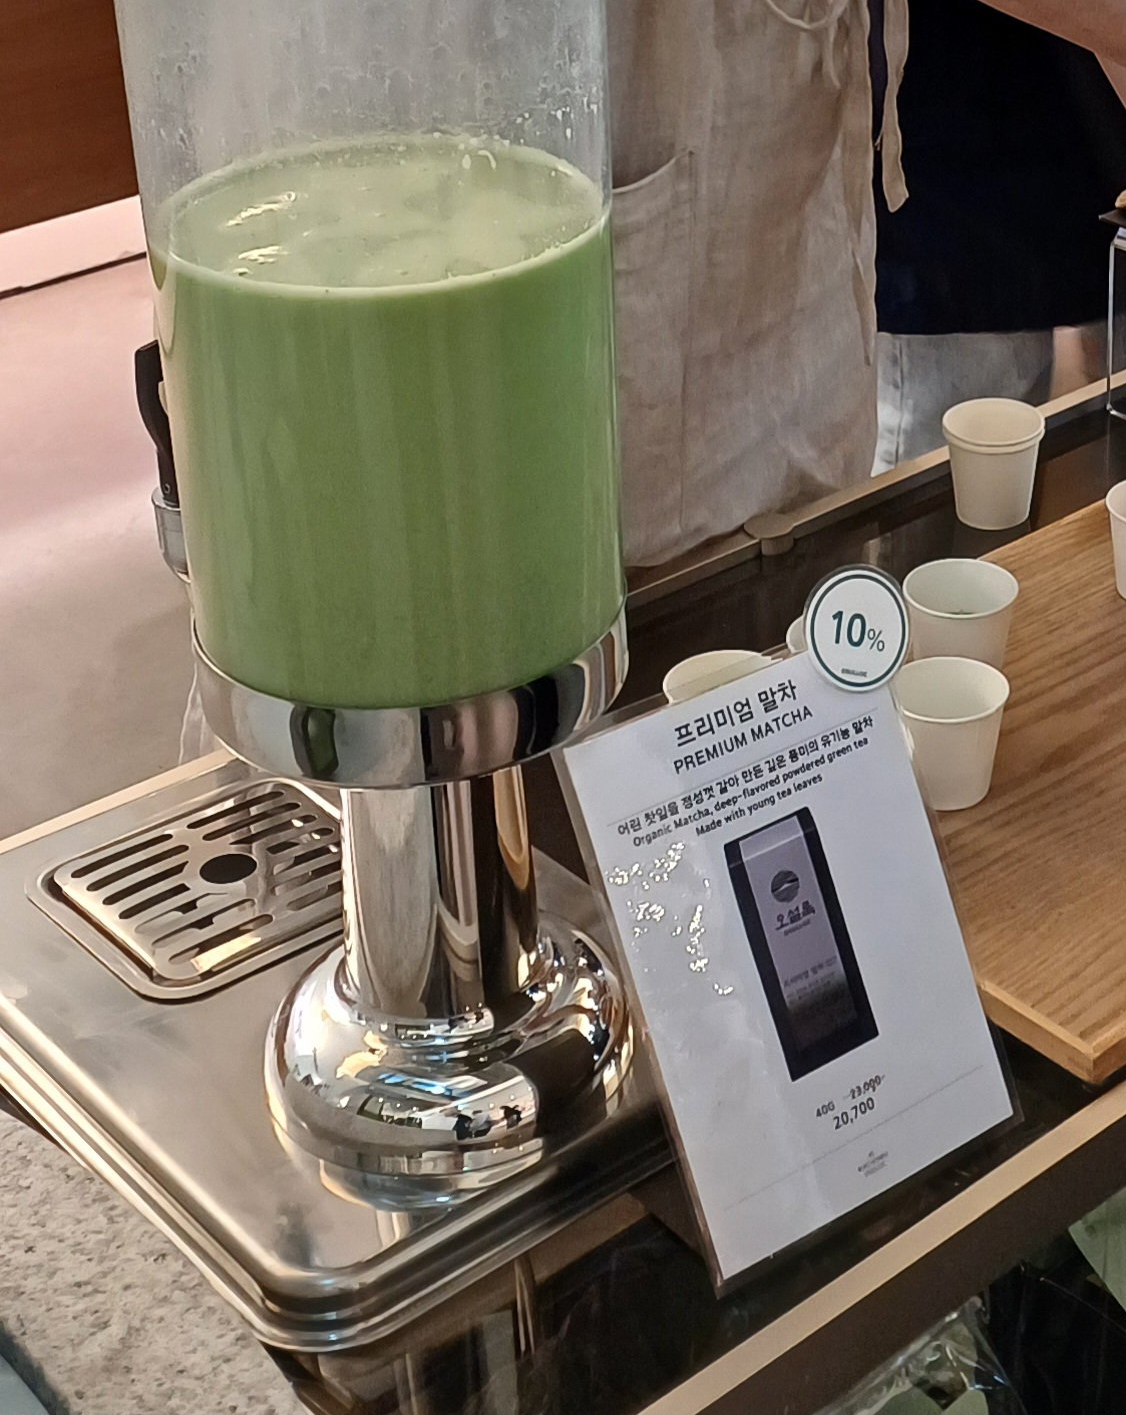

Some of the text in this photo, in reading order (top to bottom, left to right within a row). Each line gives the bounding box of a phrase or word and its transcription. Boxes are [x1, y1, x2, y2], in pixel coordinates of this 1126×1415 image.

[832, 610, 885, 652] 10%
[673, 705, 813, 775] PREMIUM MATCHA
[674, 679, 797, 747] 프리미엄 말차
[617, 817, 643, 836] 어린
[681, 785, 715, 810] 정성껏
[716, 774, 740, 796] 갈아
[741, 764, 764, 784] 만든
[764, 754, 787, 774] 깊은
[788, 739, 819, 764] 풍미의
[851, 715, 874, 735] 말차
[633, 737, 869, 847] Organic Matcha, deep-flavored powdered green tea
[696, 773, 823, 837] Made with young tea leaves
[833, 1097, 875, 1130] 20,700
[850, 1075, 881, 1100] 23,000
